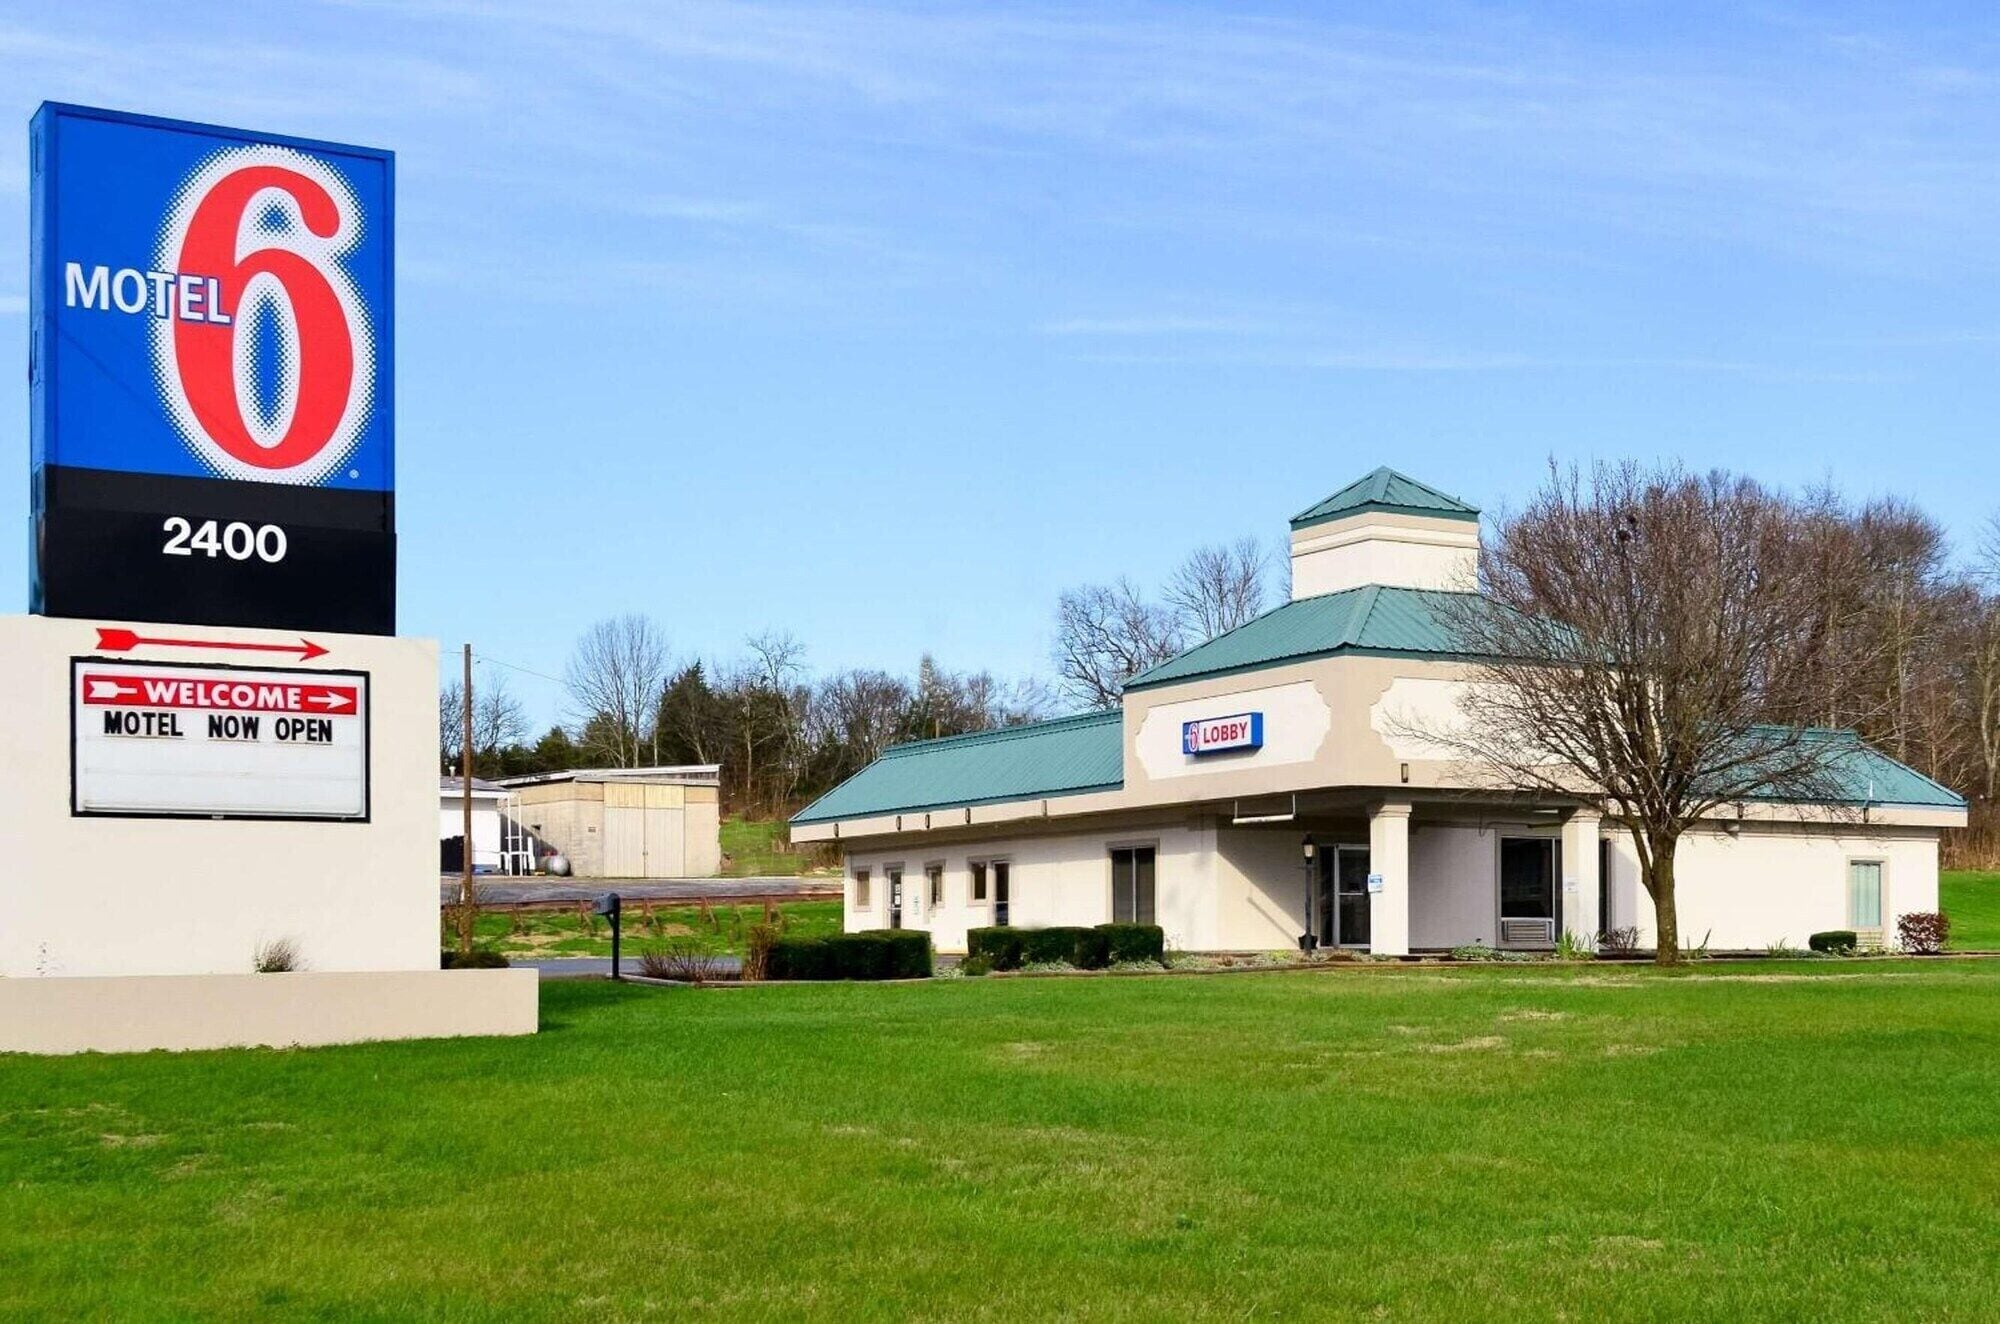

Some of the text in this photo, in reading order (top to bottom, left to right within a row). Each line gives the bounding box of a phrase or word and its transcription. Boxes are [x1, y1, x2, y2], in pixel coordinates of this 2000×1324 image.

[65, 165, 353, 469] MOTEL 6
[162, 517, 287, 563] 2400
[143, 679, 302, 710] WELCOME
[104, 711, 332, 742] MOTEL NOW OPEN
[1203, 722, 1248, 744] LOBBY
